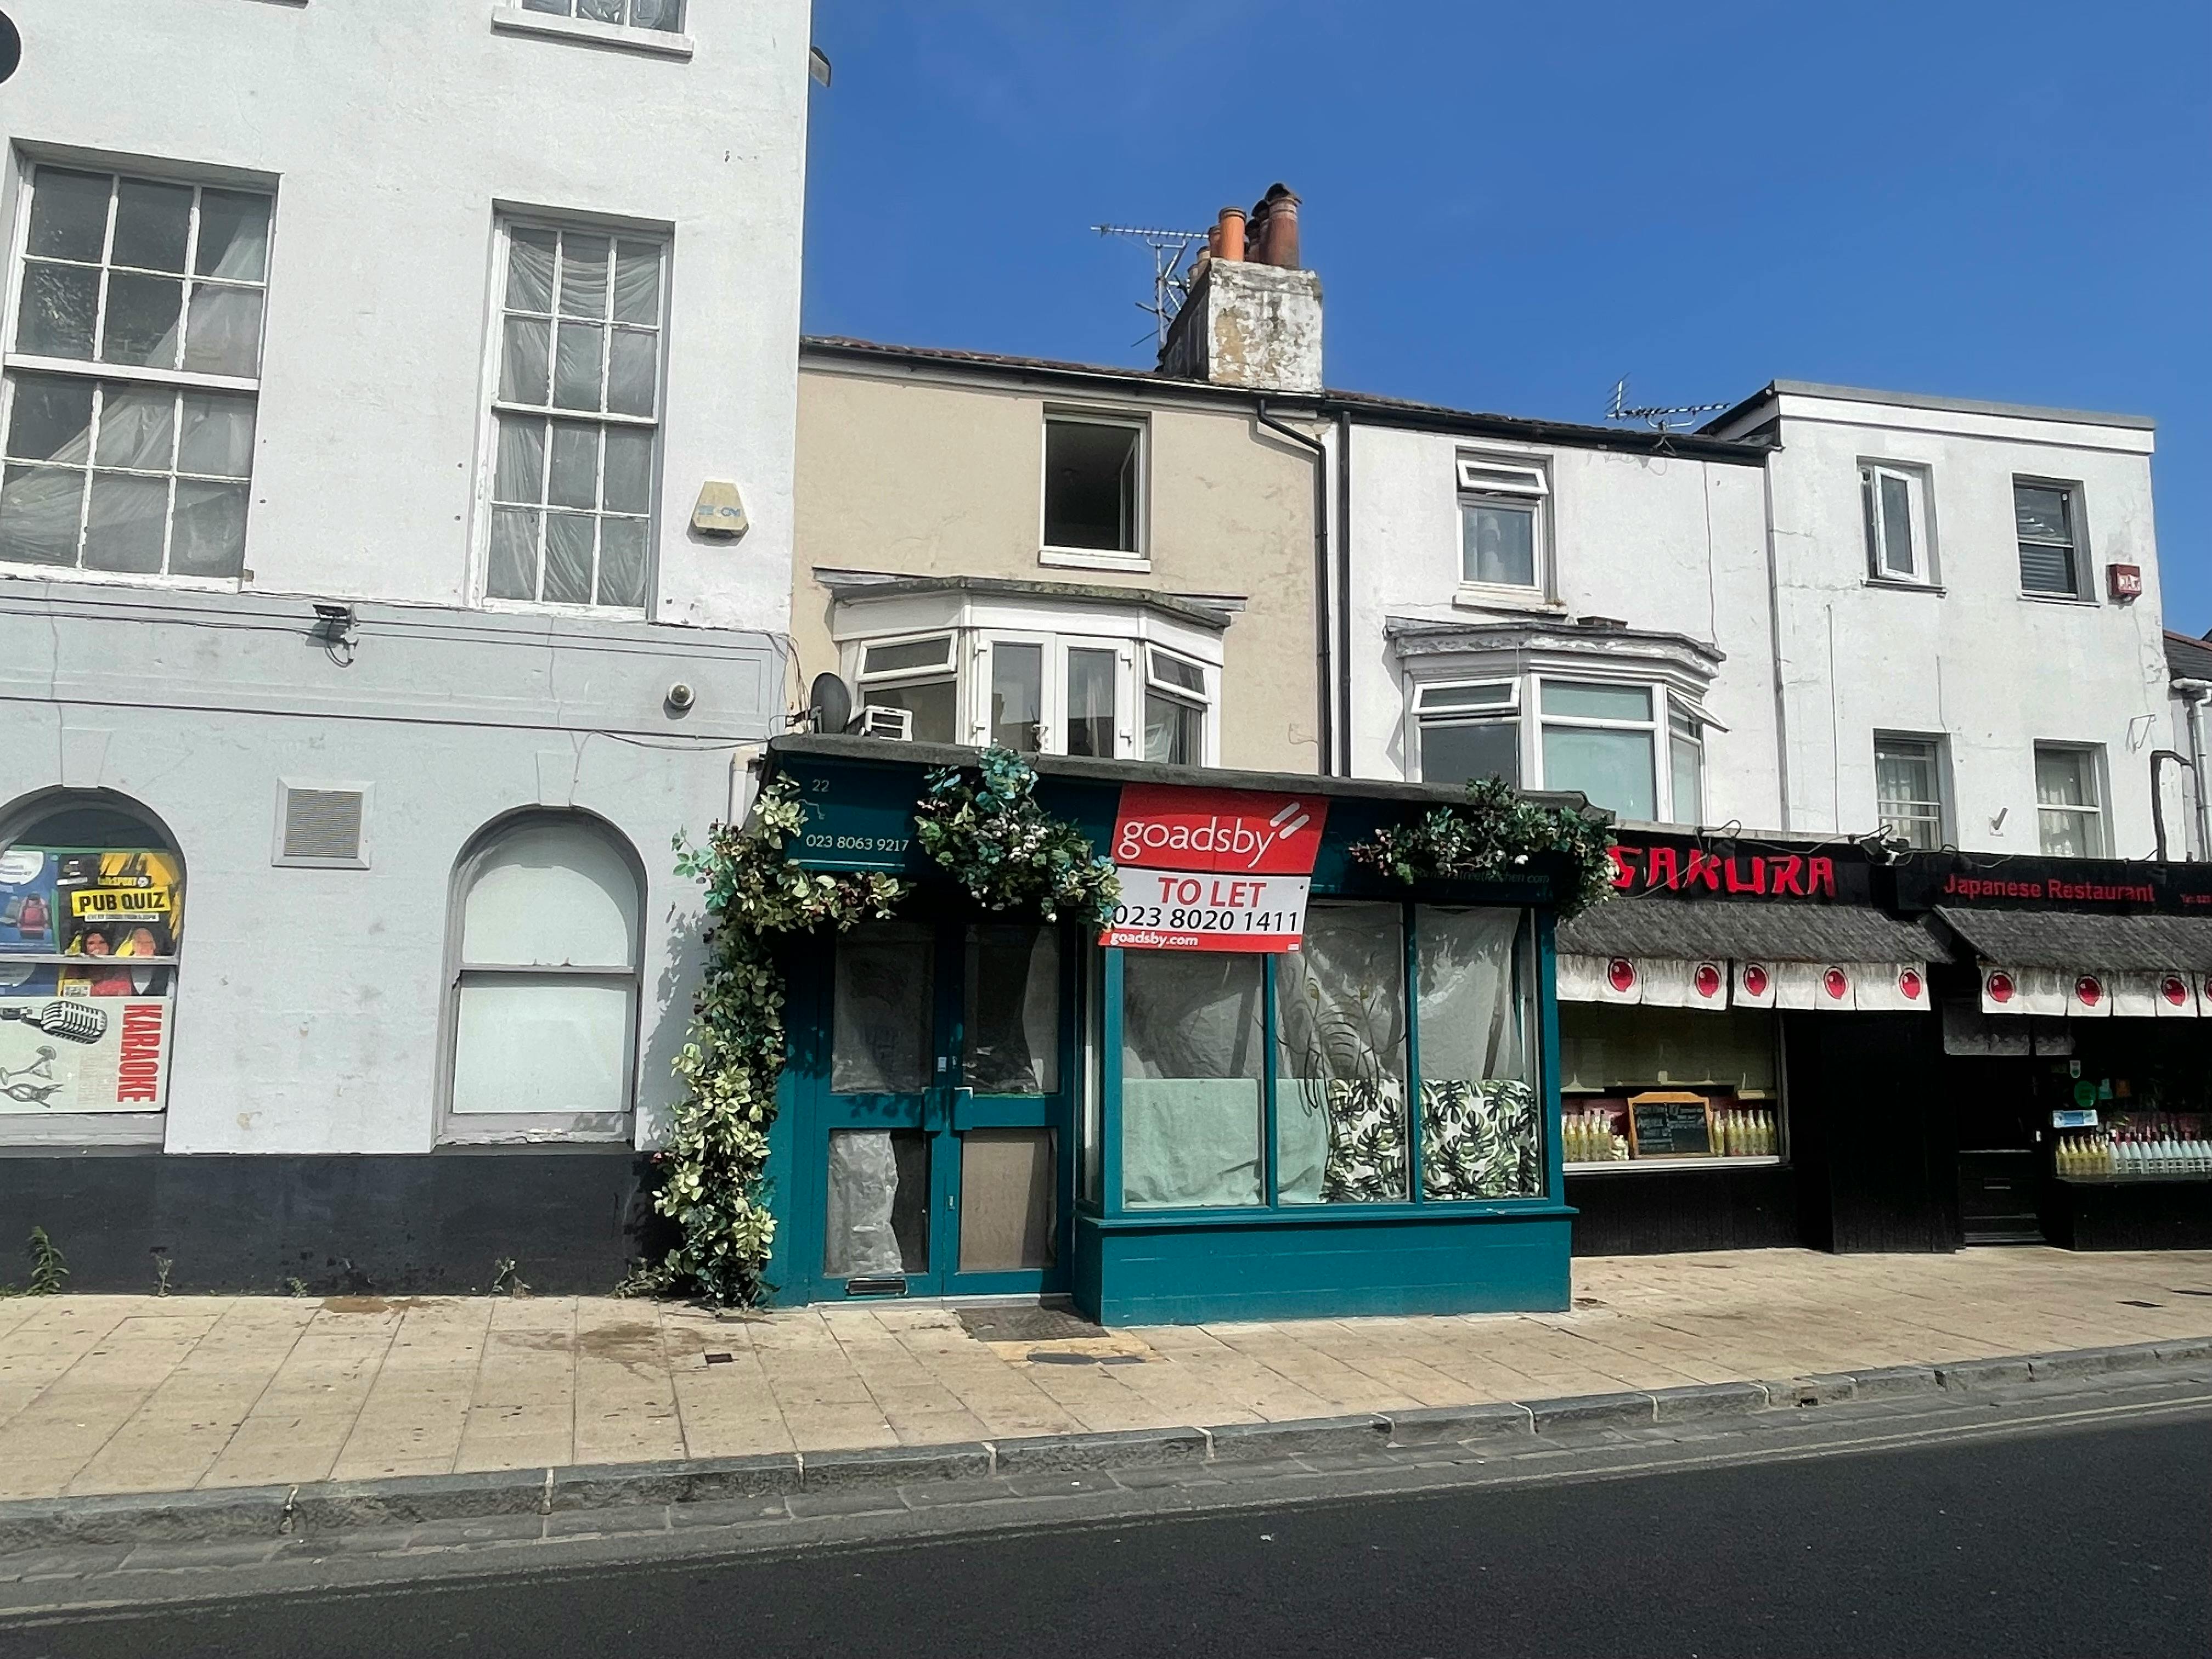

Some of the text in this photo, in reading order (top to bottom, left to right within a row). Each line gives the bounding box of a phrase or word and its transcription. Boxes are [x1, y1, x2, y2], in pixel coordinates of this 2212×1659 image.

[812, 779, 830, 792] 22
[805, 834, 910, 851] 023 8063 9217
[1117, 816, 1276, 869] goadsby
[1606, 845, 1836, 898] SAKURA
[79, 891, 165, 912] PUB QUIZ
[1158, 877, 1267, 907] TO LET
[1943, 874, 2042, 900] Japanese
[2048, 878, 2155, 902] Restaurant
[1113, 905, 1298, 932] 023 8020 1411
[1109, 932, 1199, 947] goadsby.com
[116, 1004, 163, 1103] KARAOKE
